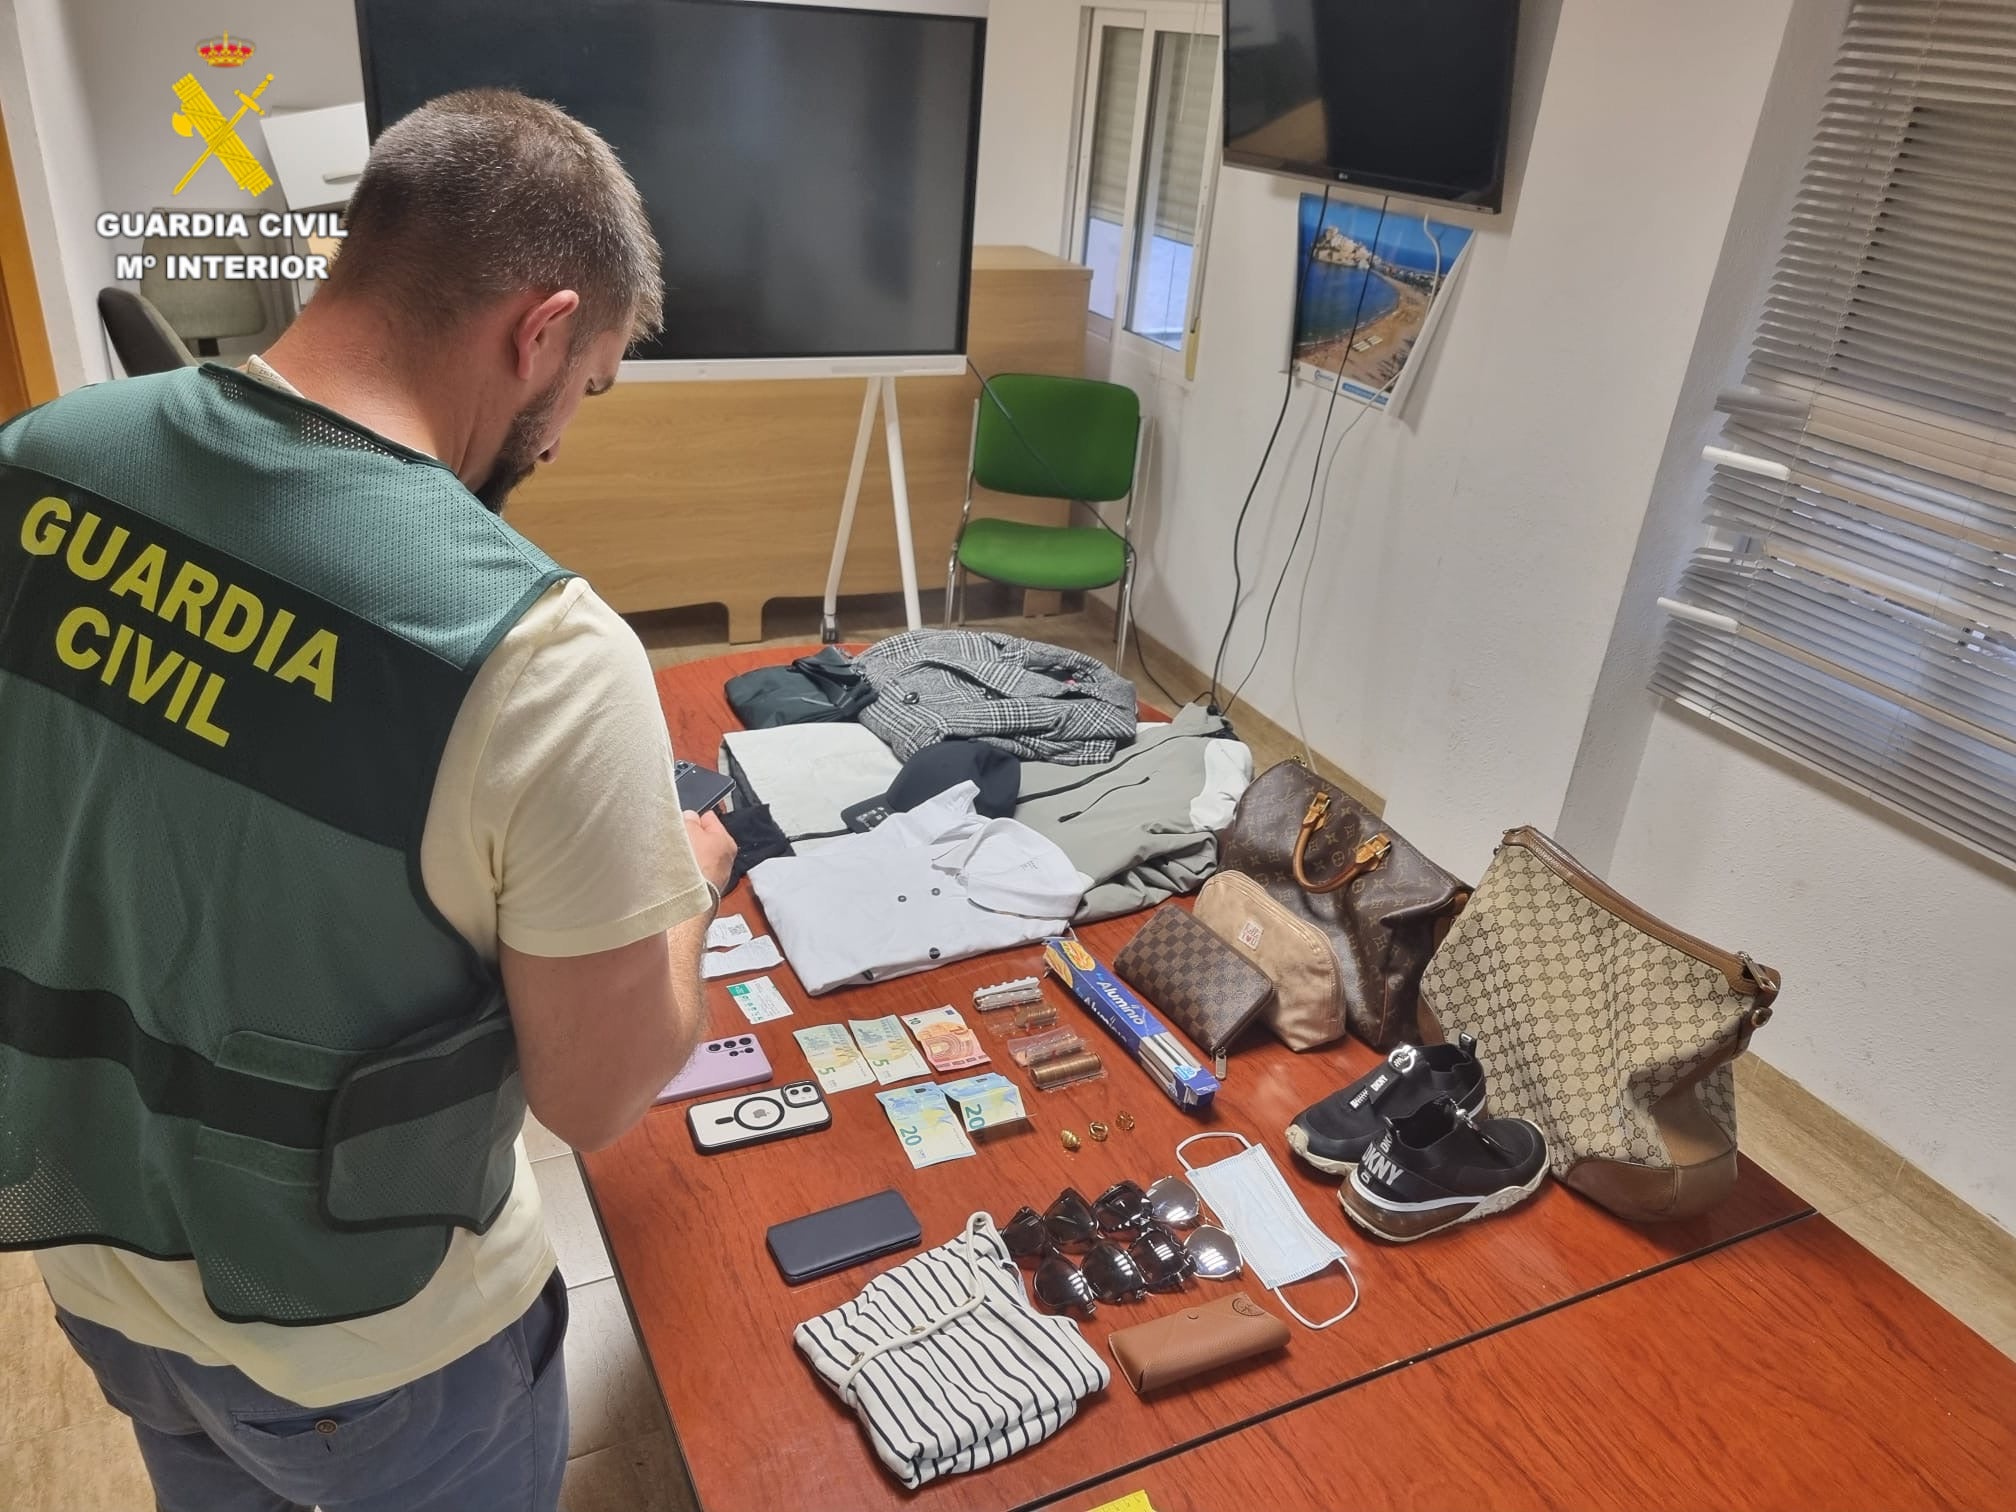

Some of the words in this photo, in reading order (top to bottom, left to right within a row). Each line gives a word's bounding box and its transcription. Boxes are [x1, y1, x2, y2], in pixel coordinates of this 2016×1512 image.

[20, 496, 338, 702] GUARDIA
[55, 606, 230, 747] CIVIL
[818, 1066, 836, 1075] 5
[872, 1059, 890, 1067] 5
[965, 1104, 985, 1130] 20
[900, 1125, 922, 1146] 20
[1362, 1141, 1404, 1186] DKNY
